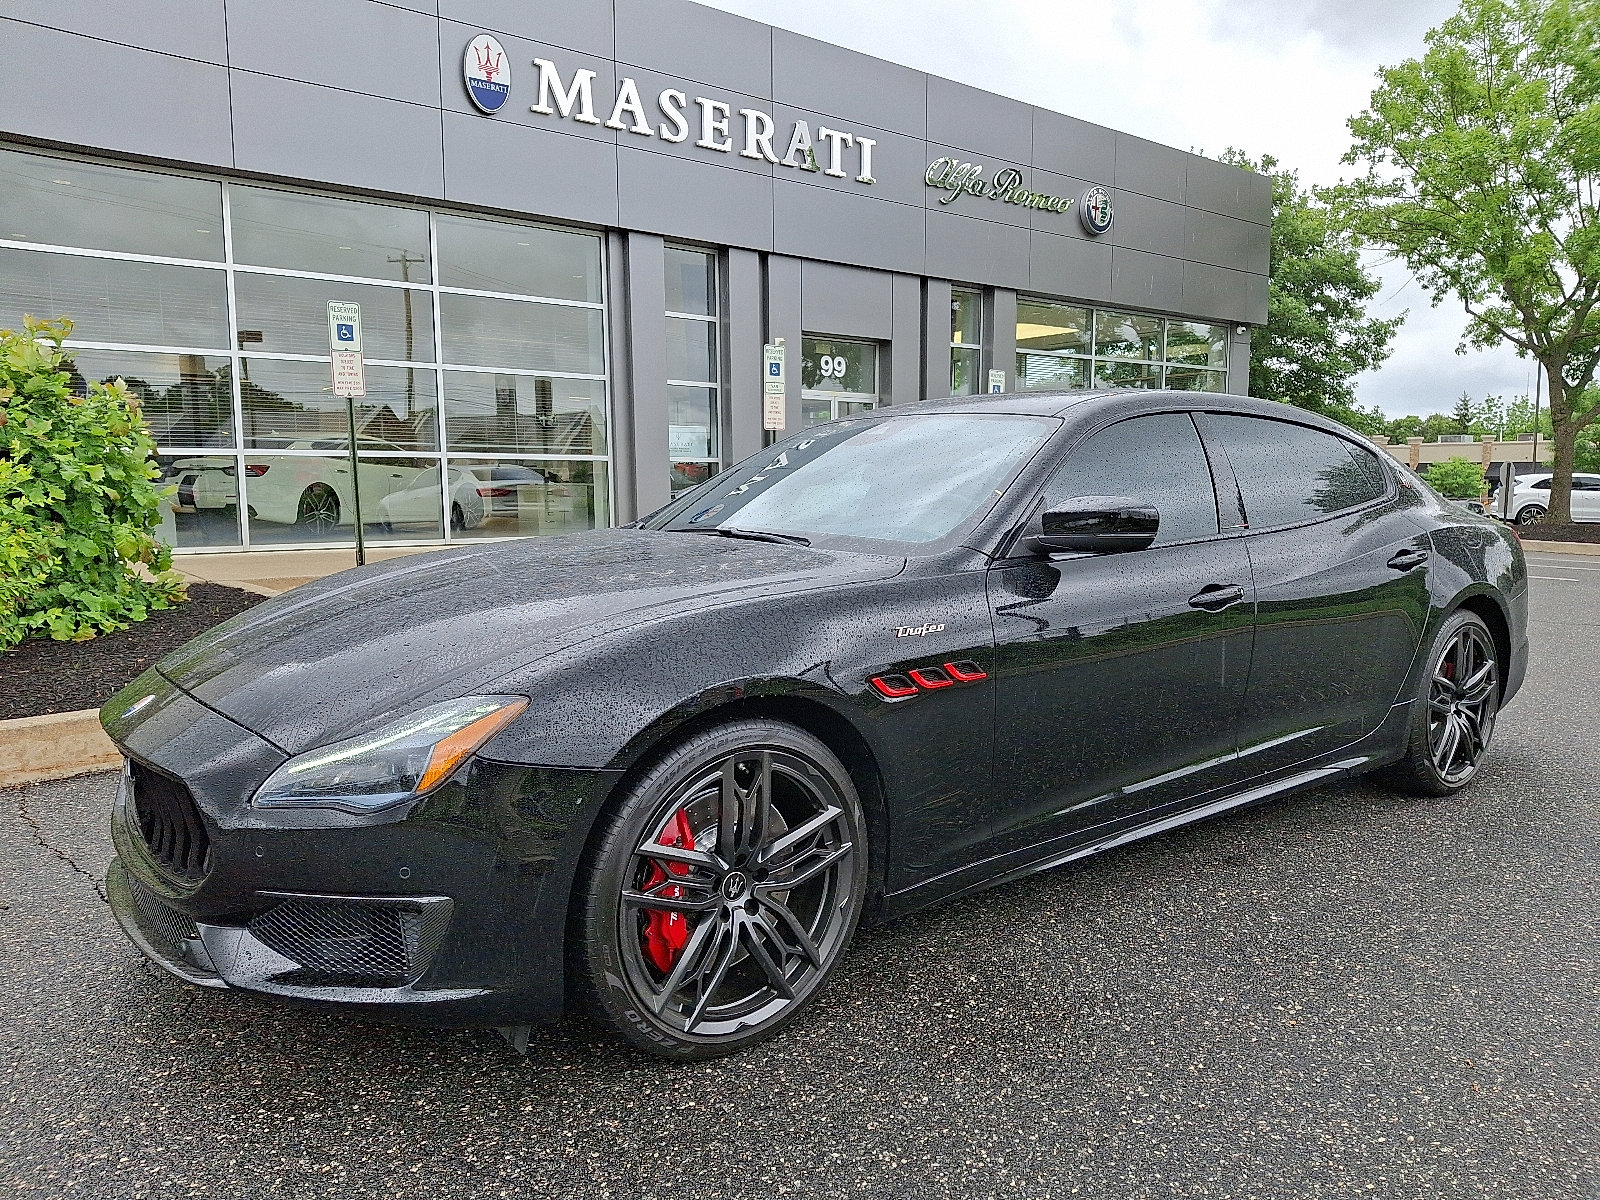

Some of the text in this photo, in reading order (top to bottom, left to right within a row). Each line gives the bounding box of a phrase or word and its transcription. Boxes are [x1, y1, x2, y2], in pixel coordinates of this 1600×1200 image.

[470, 80, 508, 93] MASERATI
[530, 58, 877, 184] MASERATI
[924, 157, 1075, 213] Alfa Romeo
[330, 305, 357, 314] RESERVED
[820, 355, 846, 377] 99
[894, 623, 946, 638] Trofeo
[624, 1010, 678, 1048] ZERO
